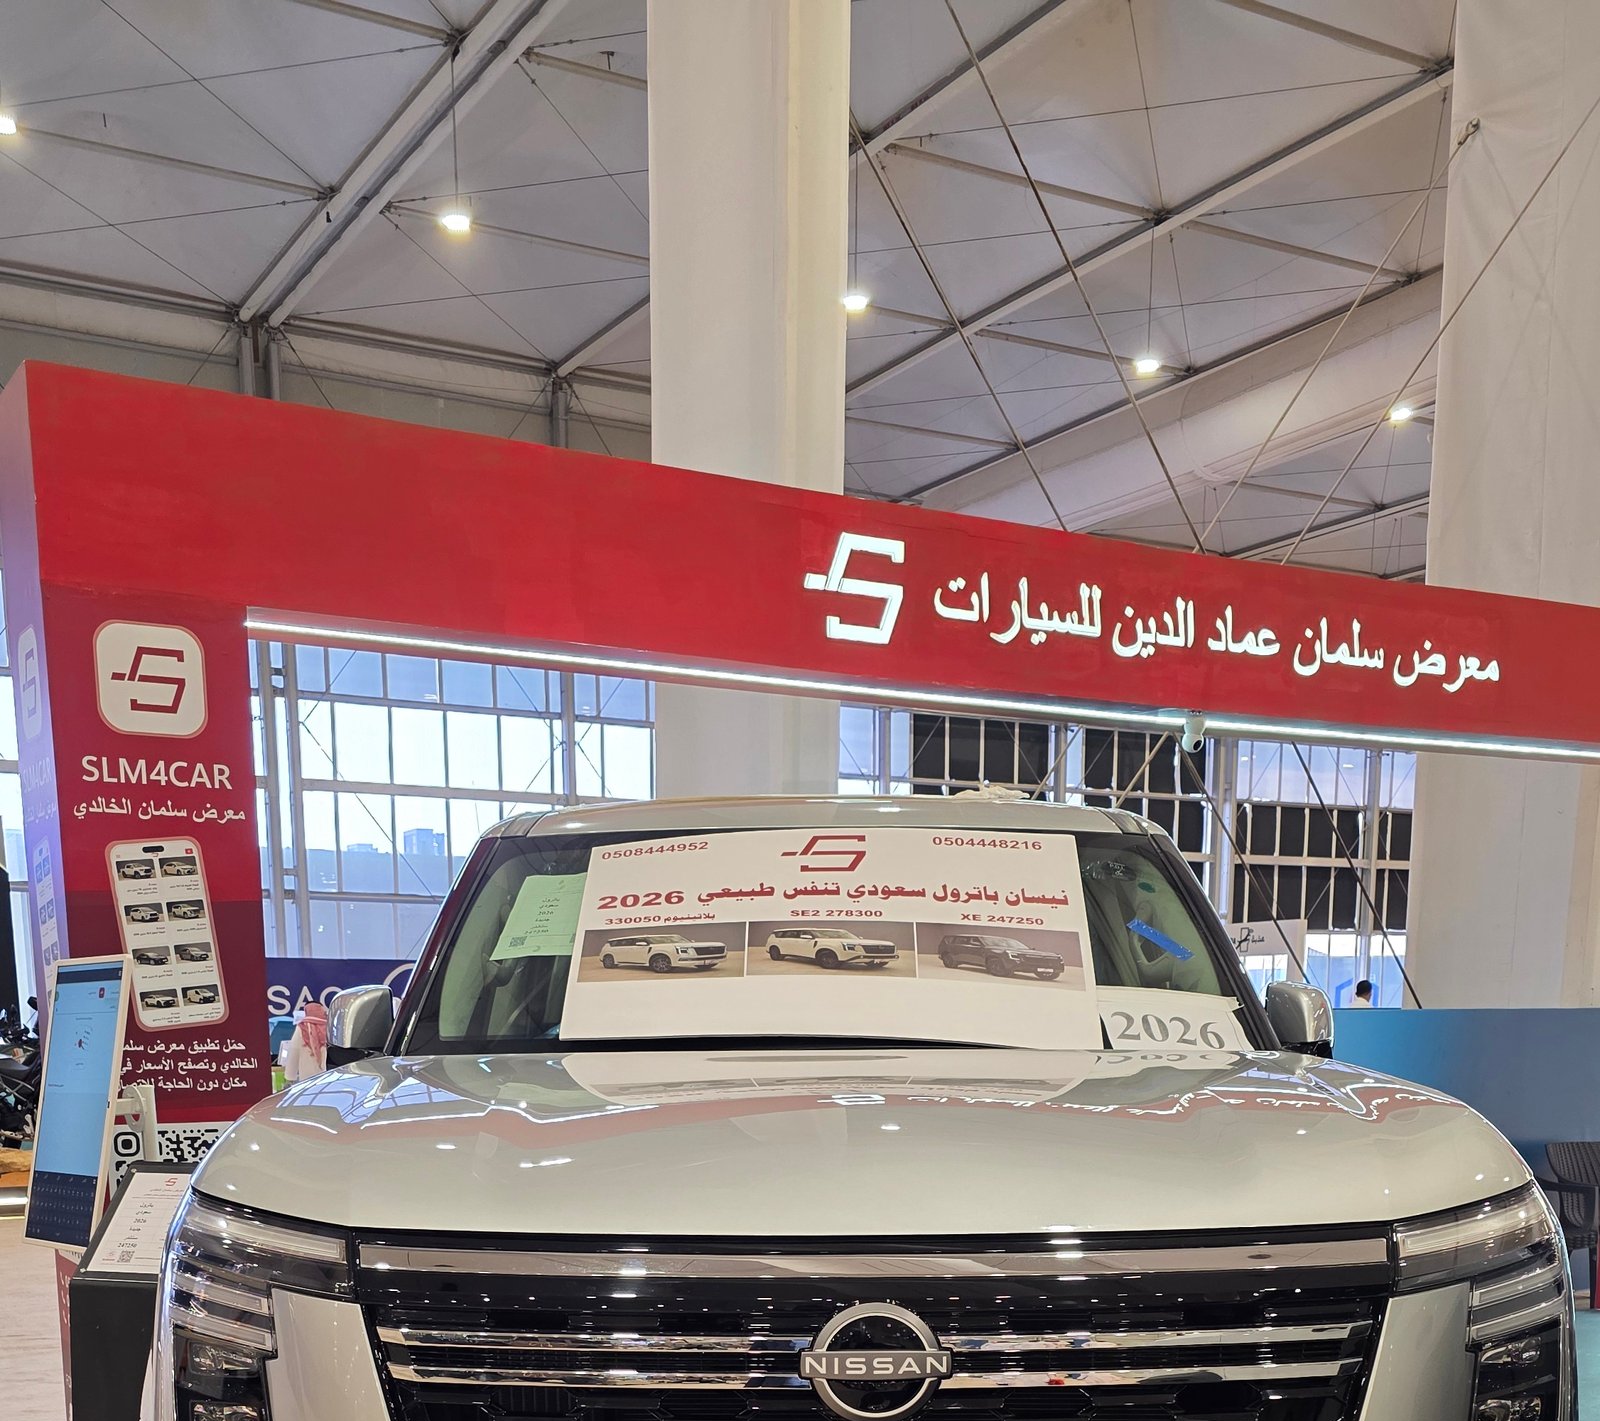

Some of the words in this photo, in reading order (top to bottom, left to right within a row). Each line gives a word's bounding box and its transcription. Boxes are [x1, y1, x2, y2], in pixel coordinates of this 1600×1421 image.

[933, 571, 1102, 645] للسيارات
[1112, 596, 1195, 658] الدين
[1207, 604, 1281, 656] عماد
[1293, 616, 1385, 676] سلمان
[1393, 639, 1500, 693] معرض
[81, 755, 233, 790] SLM4CAR
[73, 795, 132, 819] الخالدي
[138, 799, 187, 820] سلمان
[192, 802, 246, 824] معرض
[601, 840, 709, 861] 0508444952
[932, 836, 1043, 851] 0504448216
[597, 890, 685, 910] 2026
[697, 882, 776, 907] طبيعي
[783, 881, 841, 900] تنفس
[846, 884, 927, 903] سعودي
[932, 883, 999, 905] باترول
[1005, 888, 1069, 909] نيسان
[605, 915, 661, 925] 330050
[664, 912, 716, 924] بلاتينيوم
[790, 909, 820, 917] SE2
[825, 909, 883, 917] 278300
[961, 913, 982, 922] XE
[987, 914, 1044, 926] 247250
[1111, 1011, 1225, 1049] 2026
[122, 1039, 144, 1051] سلم
[147, 1039, 185, 1054] معرض
[188, 1039, 220, 1055] تطبيق
[136, 1058, 174, 1074] الأسعار
[177, 1059, 217, 1075] وتصفح
[220, 1057, 258, 1074] الخالدي
[118, 1077, 155, 1091] للاتصا
[158, 1076, 193, 1090] الحاجة
[196, 1079, 219, 1091] دون
[221, 1077, 247, 1091] مكان
[805, 1356, 947, 1375] NISSAN
